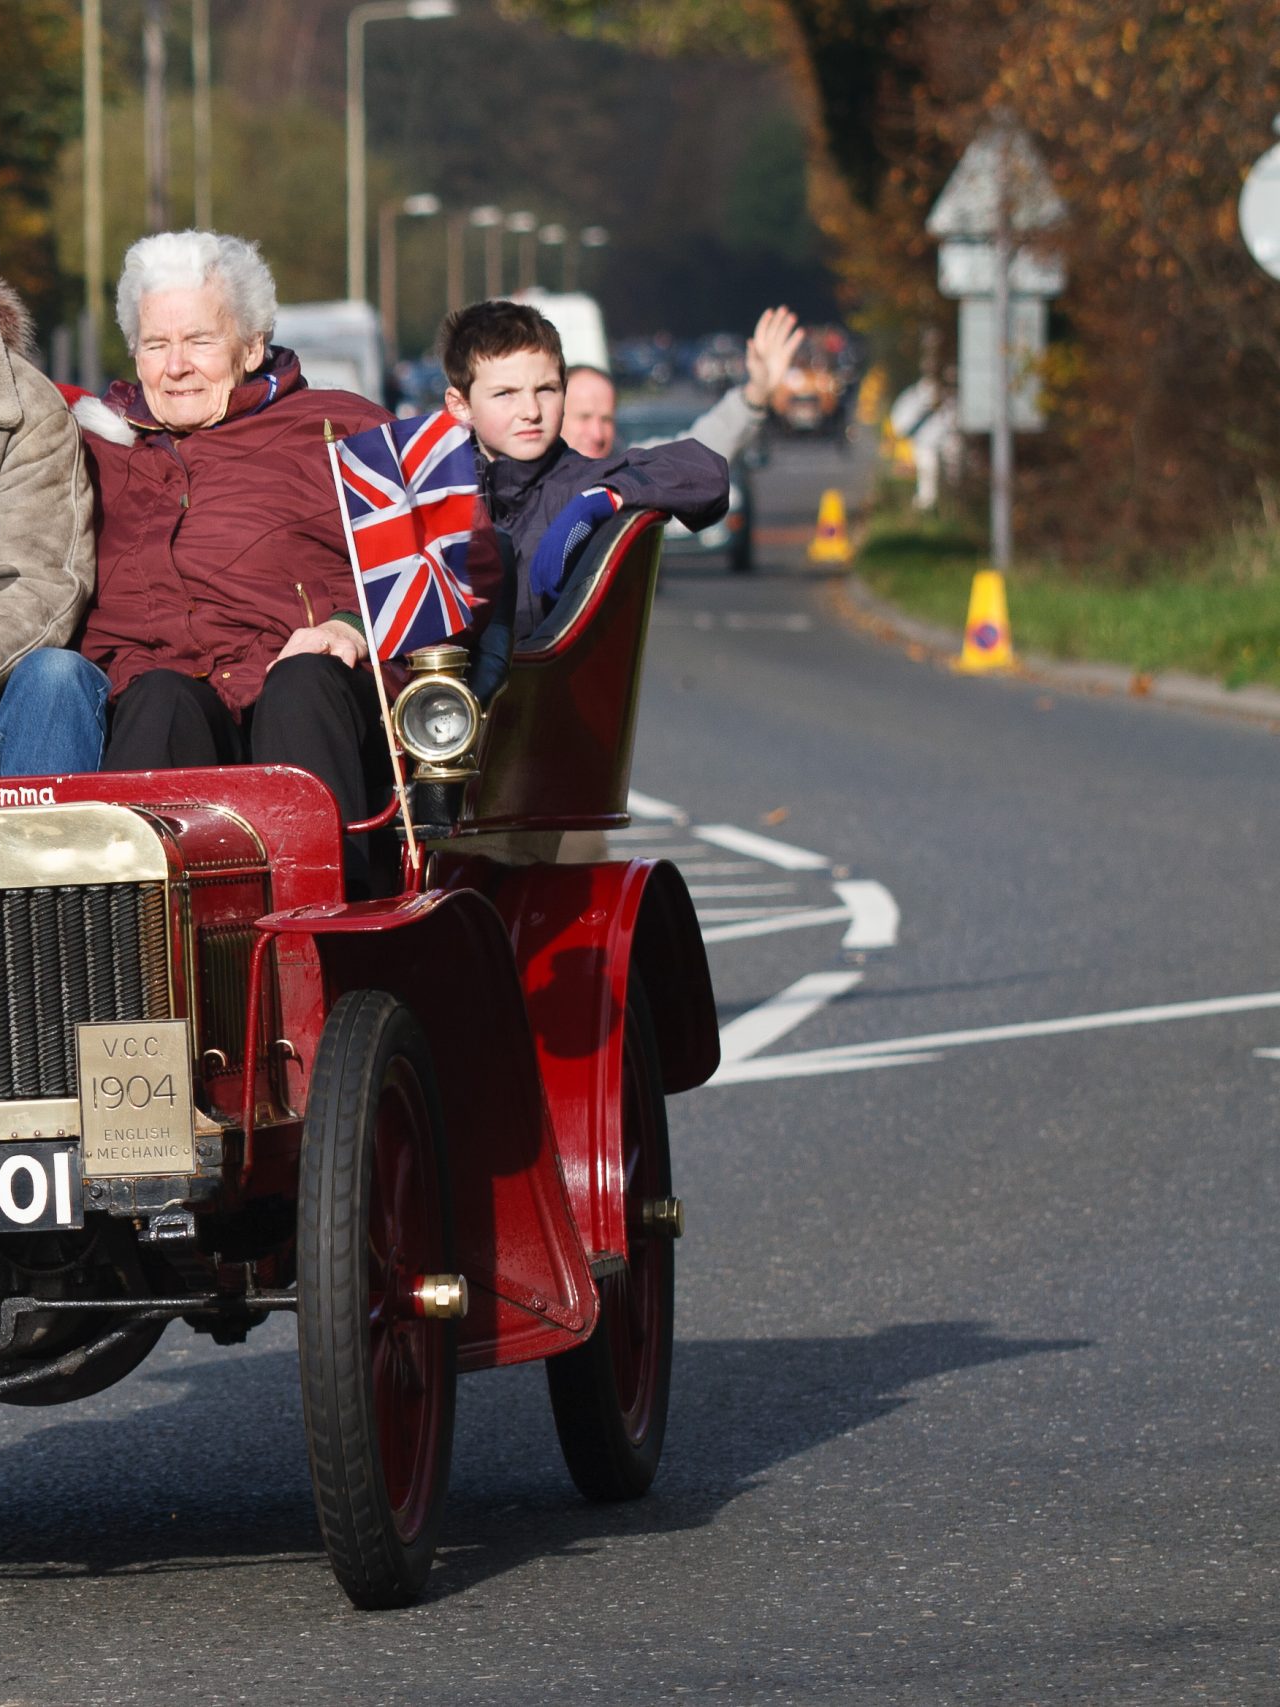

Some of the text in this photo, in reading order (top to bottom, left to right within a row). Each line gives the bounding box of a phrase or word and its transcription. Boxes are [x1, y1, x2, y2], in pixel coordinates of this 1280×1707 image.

[102, 1036, 164, 1058] V.C.C.
[93, 1074, 177, 1110] 1904
[104, 1127, 170, 1142] ENGLISH
[97, 1145, 179, 1160] MECHANIC
